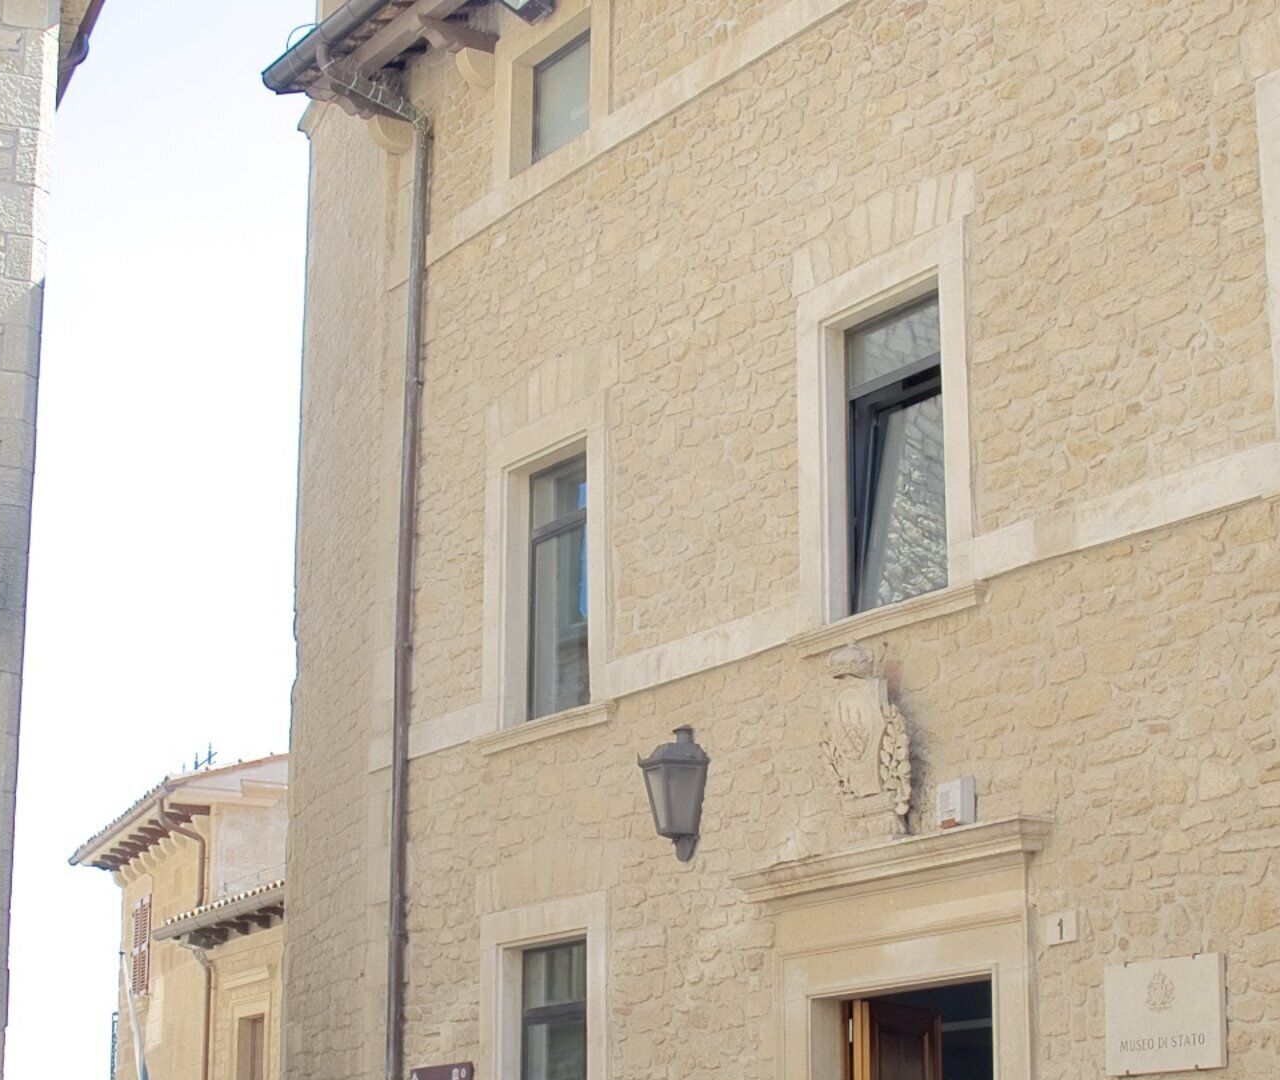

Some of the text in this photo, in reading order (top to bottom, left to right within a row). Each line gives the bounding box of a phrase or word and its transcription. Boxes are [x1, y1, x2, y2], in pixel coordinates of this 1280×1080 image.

[1057, 918, 1064, 940] 1
[1120, 1033, 1206, 1052] MUSEO DI STATO
